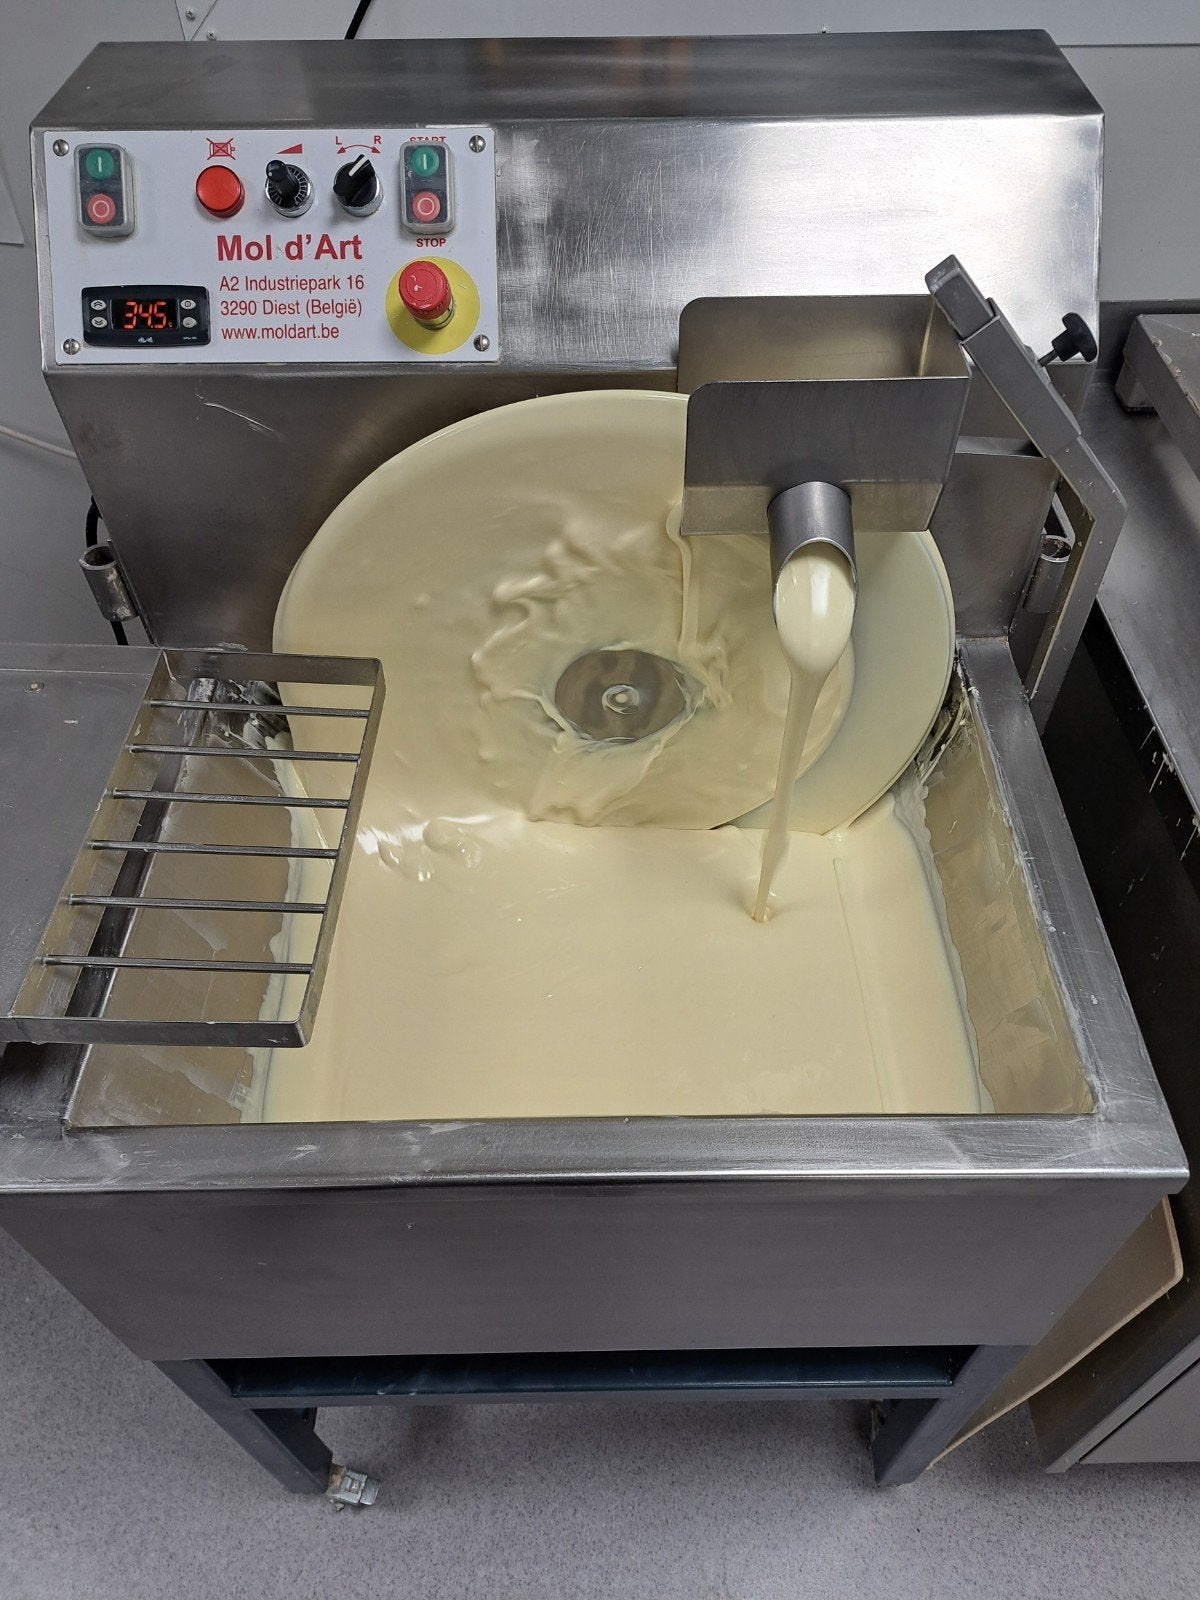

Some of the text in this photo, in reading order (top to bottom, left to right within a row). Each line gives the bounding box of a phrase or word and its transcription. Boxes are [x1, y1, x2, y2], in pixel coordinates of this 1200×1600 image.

[335, 135, 382, 146] L R
[217, 234, 273, 262] Mol
[416, 238, 447, 248] STOP
[219, 274, 365, 295] A2 Industriepark 16
[220, 298, 362, 319] 3290 Diest (België)
[221, 322, 340, 340] www.moldart.be
